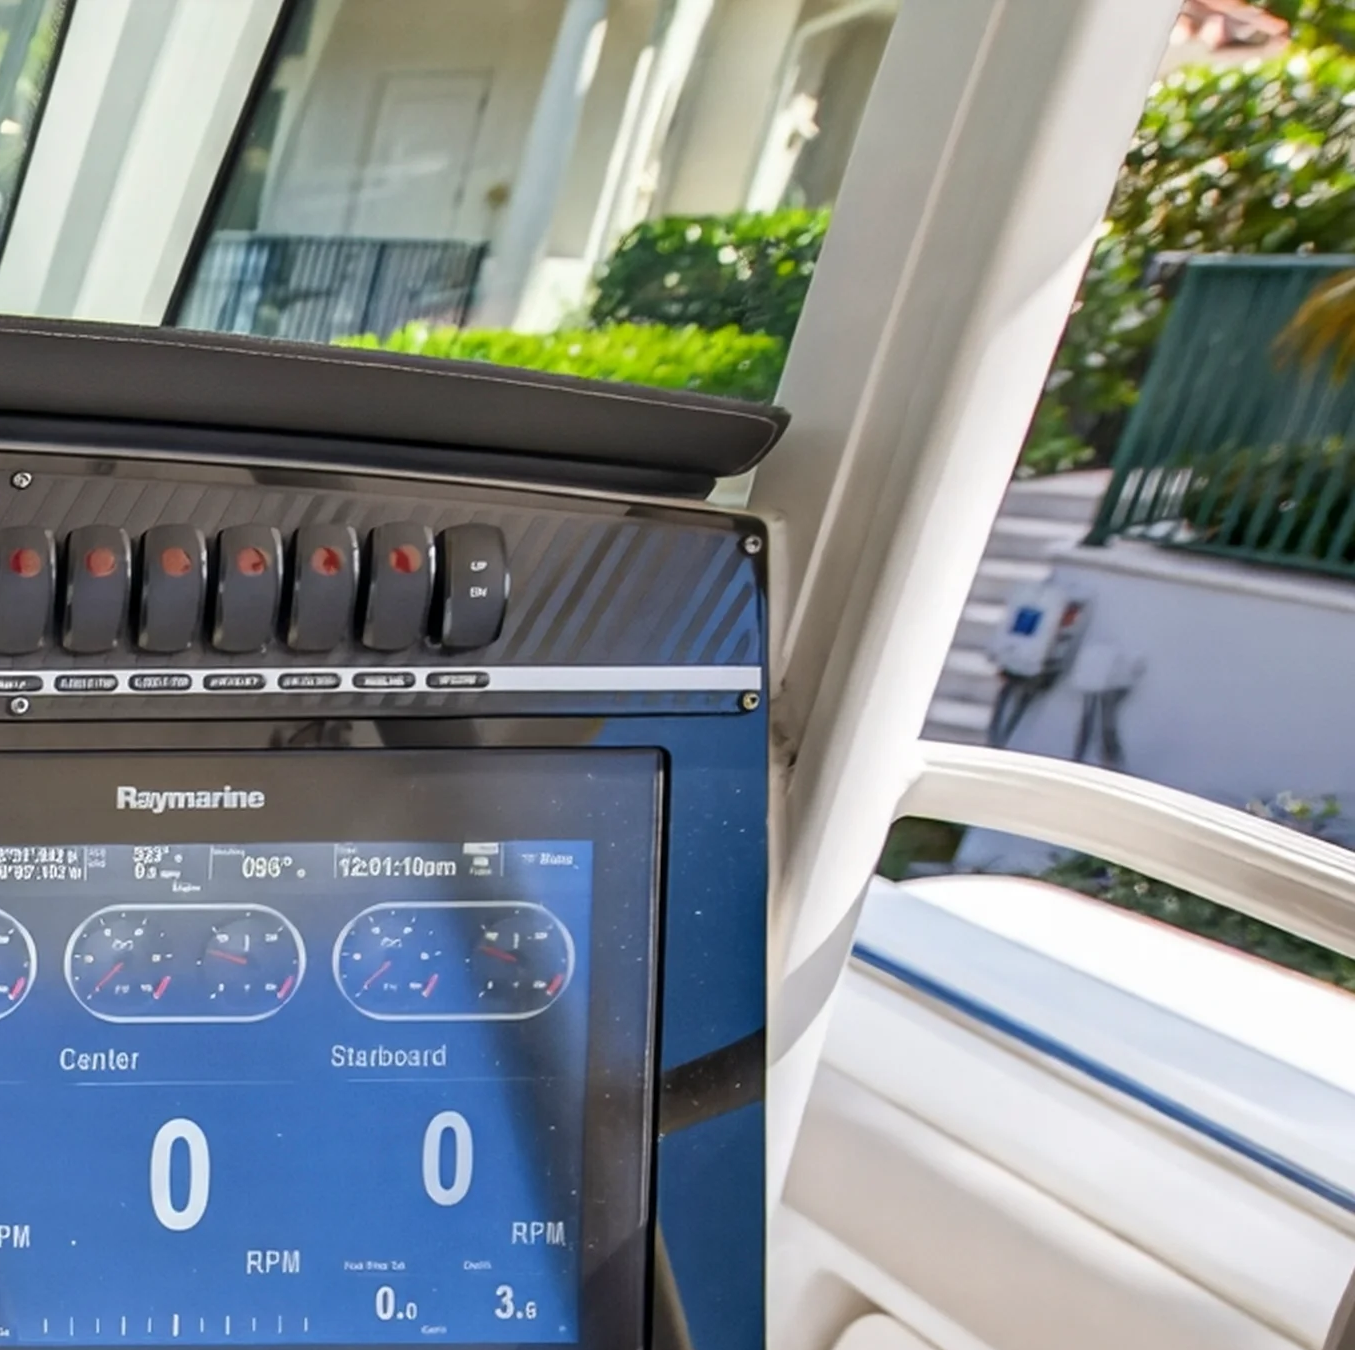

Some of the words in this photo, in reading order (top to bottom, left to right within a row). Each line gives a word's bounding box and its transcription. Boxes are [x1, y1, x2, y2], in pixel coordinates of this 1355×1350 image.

[116, 785, 265, 813] Raymarine
[59, 1047, 140, 1072] Center
[329, 1044, 448, 1069] Starboard
[422, 1110, 474, 1206] 0
[150, 1117, 211, 1231] 0
[511, 1221, 566, 1247] RPM
[246, 1250, 301, 1275] RPM
[375, 1285, 418, 1321] 0.0
